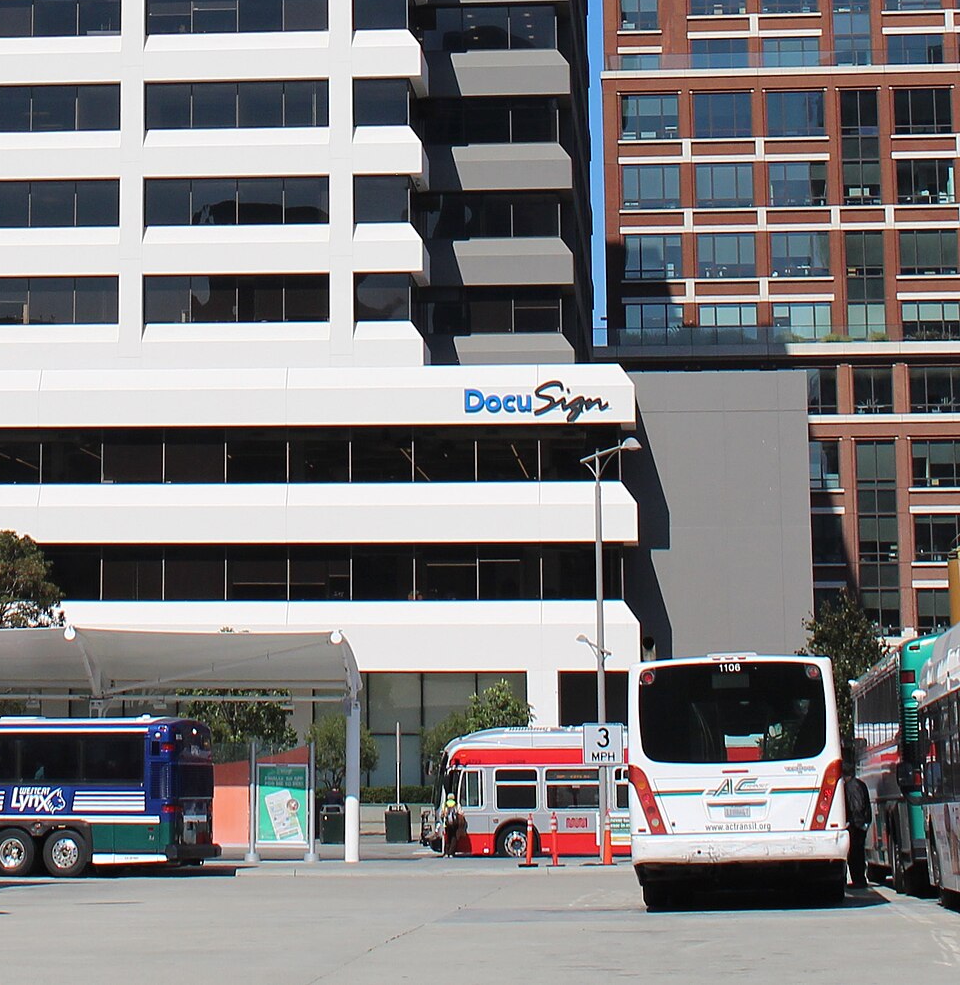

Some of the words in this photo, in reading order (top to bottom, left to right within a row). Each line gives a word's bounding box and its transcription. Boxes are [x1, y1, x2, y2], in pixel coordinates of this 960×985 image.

[464, 380, 609, 422] DocuSign
[597, 727, 610, 748] 3
[591, 751, 616, 762] MPH
[705, 822, 771, 832] www.actransit.org
